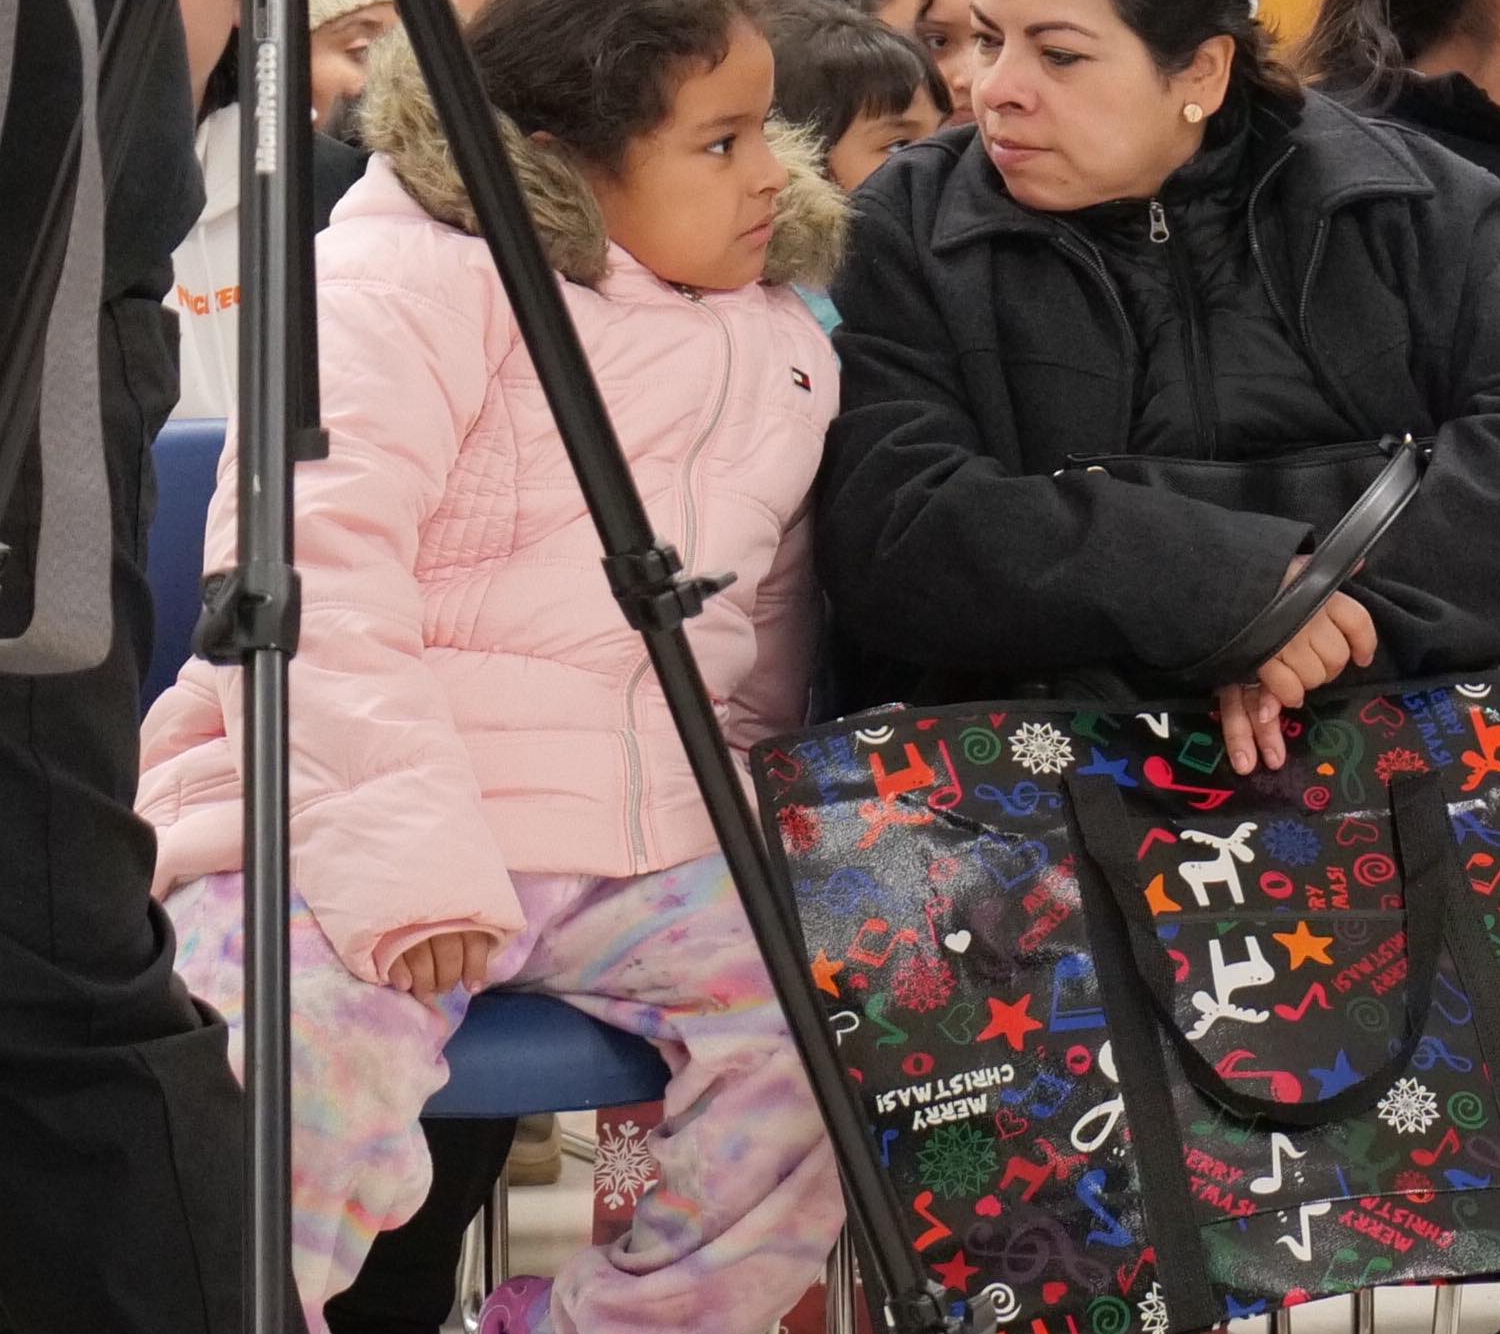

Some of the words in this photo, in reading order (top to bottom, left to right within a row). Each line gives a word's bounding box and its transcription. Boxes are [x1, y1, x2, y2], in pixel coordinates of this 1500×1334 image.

[875, 1063, 1015, 1114] CHRISTMAS!
[911, 1093, 988, 1132] MERRY
[1338, 1209, 1416, 1253] MERRY
